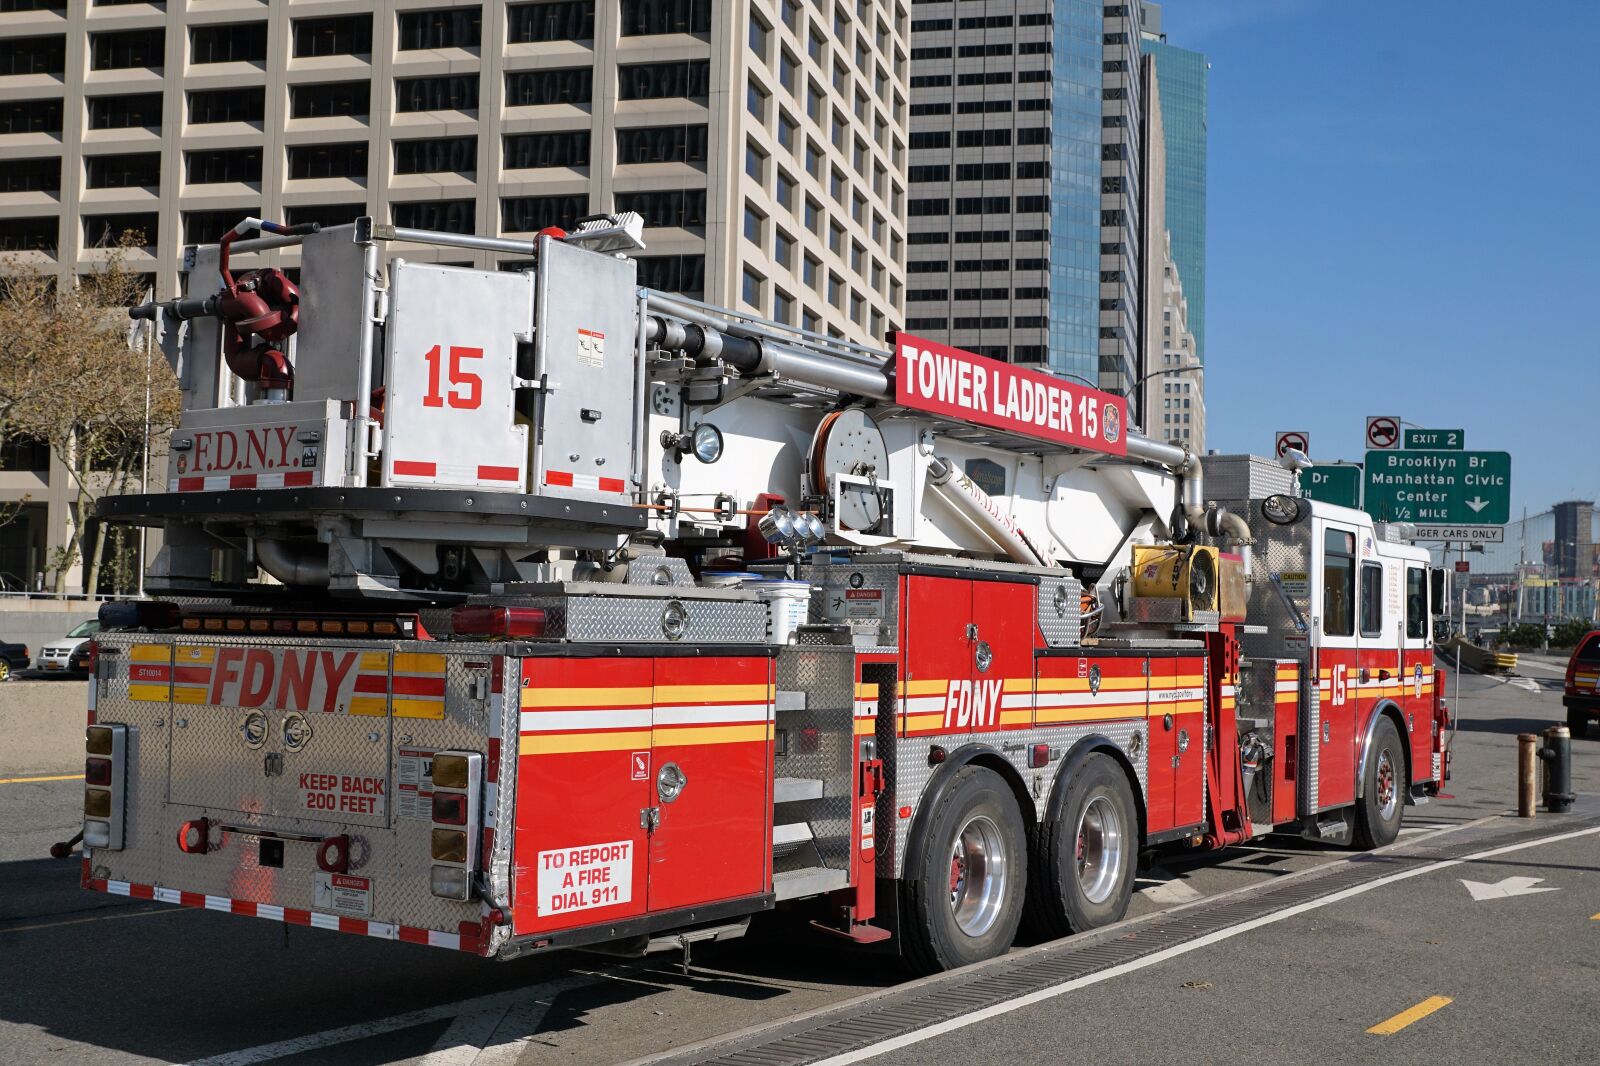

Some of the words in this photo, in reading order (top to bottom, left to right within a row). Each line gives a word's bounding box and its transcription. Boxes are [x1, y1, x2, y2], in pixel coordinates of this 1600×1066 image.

[422, 344, 484, 410] 15
[901, 344, 988, 412] TOWER
[993, 370, 1073, 433] LADDER
[1078, 395, 1098, 439] 15
[191, 425, 300, 472] F.D.N.Y.
[1412, 434, 1438, 444] EXIT
[1447, 433, 1457, 445] 2
[1388, 455, 1456, 471] Brooklyn
[1469, 456, 1488, 468] Br
[1312, 472, 1329, 484] Dr
[1372, 473, 1455, 485] Manhattan
[1464, 474, 1504, 486] Civic
[1396, 490, 1448, 502] Center
[1419, 509, 1448, 518] MILE
[1442, 529, 1469, 538] CARS
[1472, 530, 1497, 539] ONLY
[210, 646, 359, 713] FDNY
[1332, 664, 1346, 706] 15
[944, 679, 1003, 728] FDNY
[300, 773, 338, 792] KEEP
[341, 776, 385, 796] BACK
[307, 793, 336, 810] 200
[339, 797, 377, 814] FEET
[543, 852, 565, 870] TO
[569, 844, 630, 867] REPORT
[562, 872, 574, 889] A
[578, 866, 611, 887] FIRE
[551, 891, 588, 911] DIAL
[592, 885, 619, 904] 911
